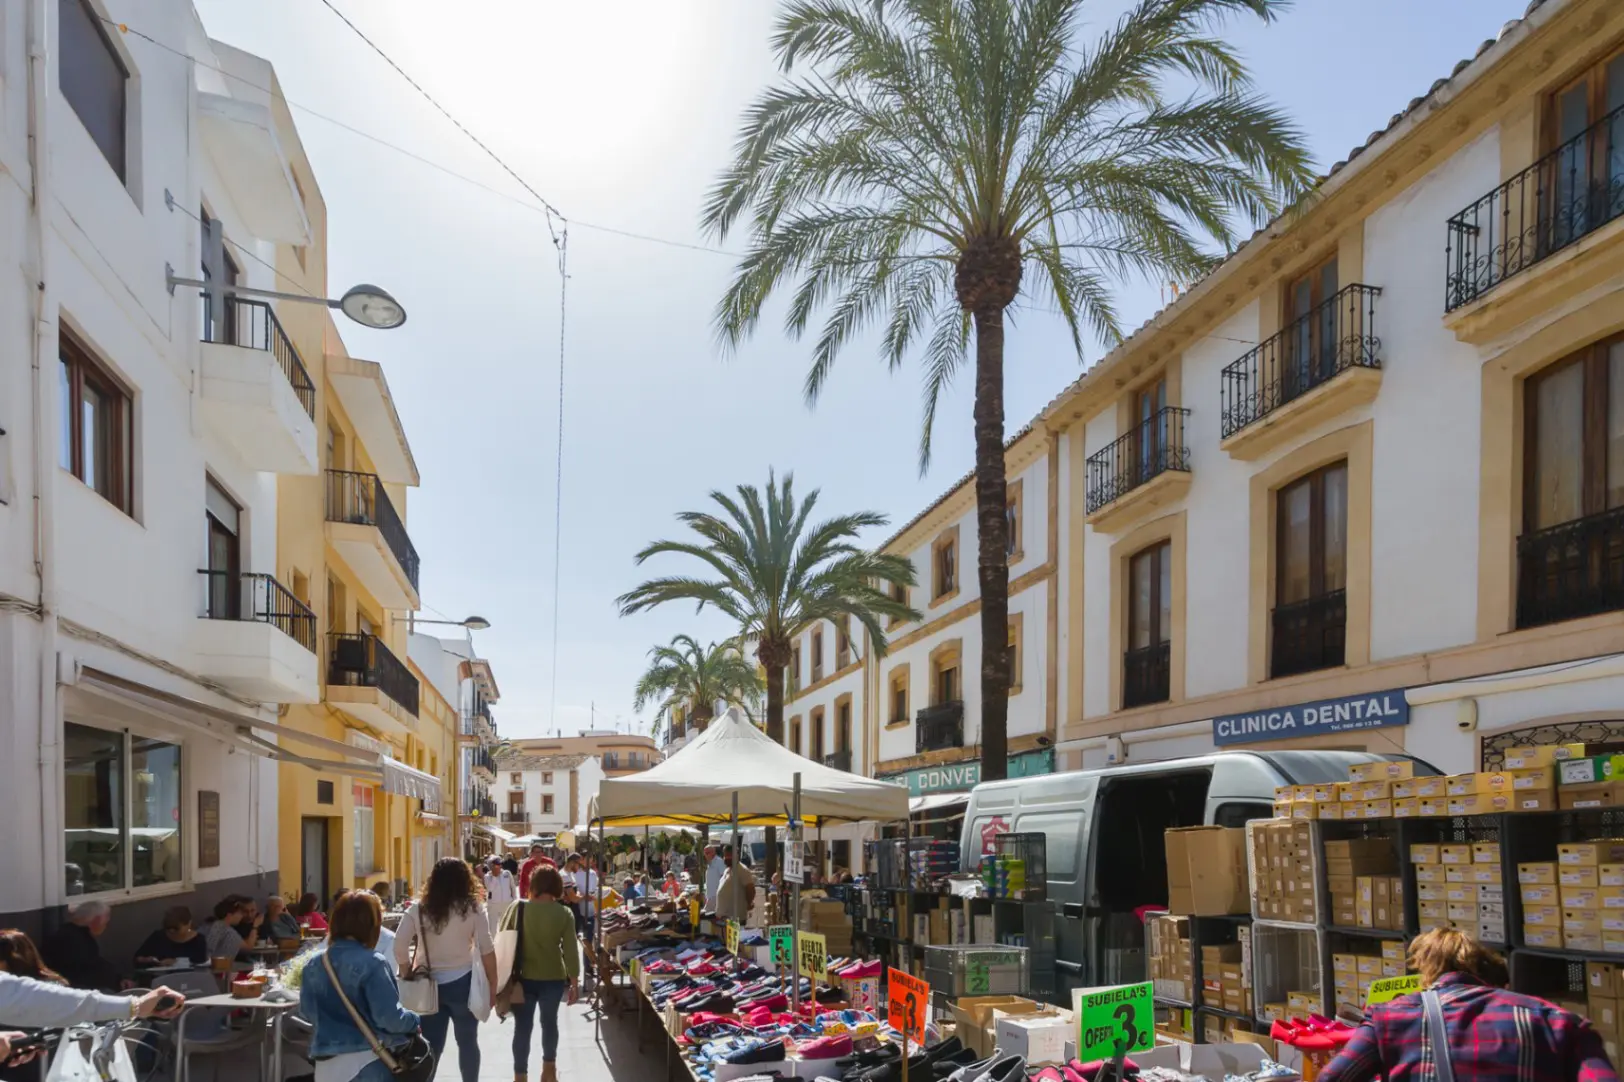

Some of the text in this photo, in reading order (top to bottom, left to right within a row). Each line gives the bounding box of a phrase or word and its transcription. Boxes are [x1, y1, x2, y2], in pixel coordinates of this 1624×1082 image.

[1218, 696, 1399, 737] CLINICA DENTAL
[918, 765, 982, 789] CONVE
[801, 939, 823, 954] OFERTA
[1373, 977, 1418, 993] SUBIELA'S
[1087, 986, 1147, 1008] SUBIELA'S
